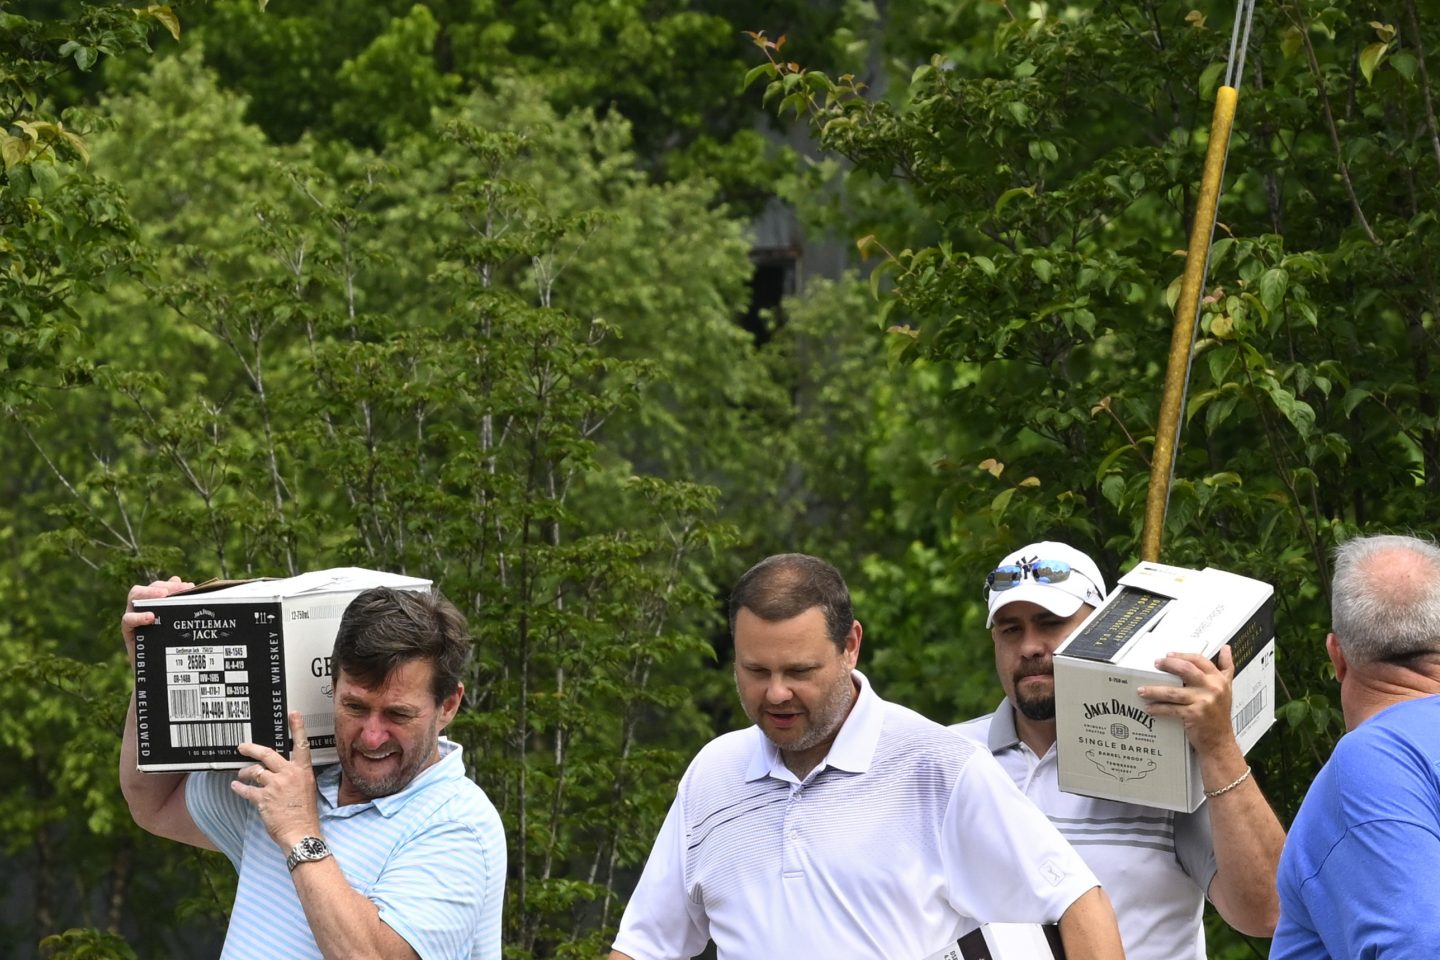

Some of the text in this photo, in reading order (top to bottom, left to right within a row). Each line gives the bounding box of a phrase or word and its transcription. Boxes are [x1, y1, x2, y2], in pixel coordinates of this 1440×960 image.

[173, 619, 236, 629] GENTLEMAN
[192, 630, 218, 640] JACK
[136, 635, 150, 757] DOUBLE MELLOWED
[269, 632, 284, 753] TENNESSEE WHISKEY
[1083, 702, 1111, 719] JACK
[1078, 736, 1163, 757] SINGLE BARREL
